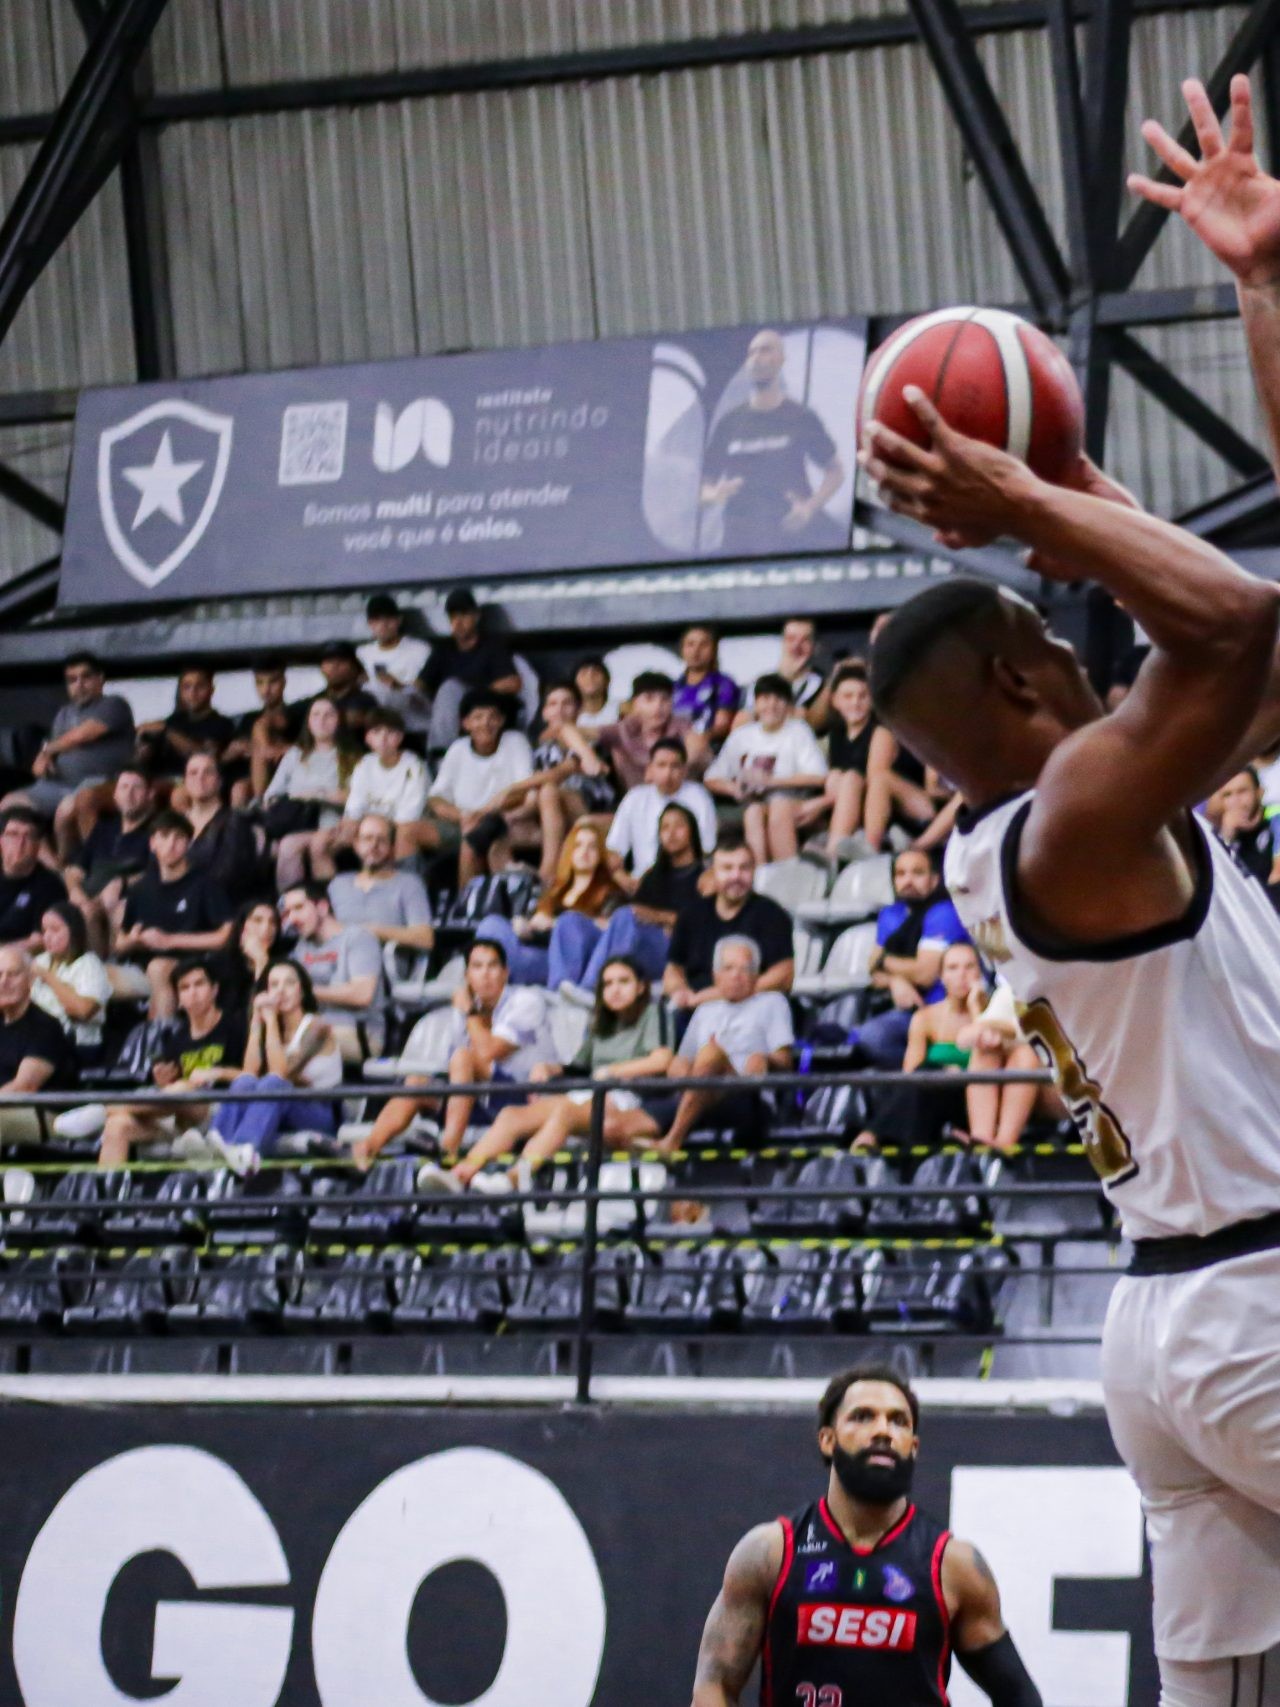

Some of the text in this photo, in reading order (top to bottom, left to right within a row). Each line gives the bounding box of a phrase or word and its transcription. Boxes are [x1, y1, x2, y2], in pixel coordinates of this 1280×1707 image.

[475, 402, 610, 436] nutrindo
[473, 435, 570, 464] ideais
[376, 490, 434, 520] multi
[434, 494, 486, 520] para
[488, 485, 571, 511] atender
[343, 525, 394, 551] você
[397, 527, 437, 553] que
[807, 1606, 906, 1649] SESI
